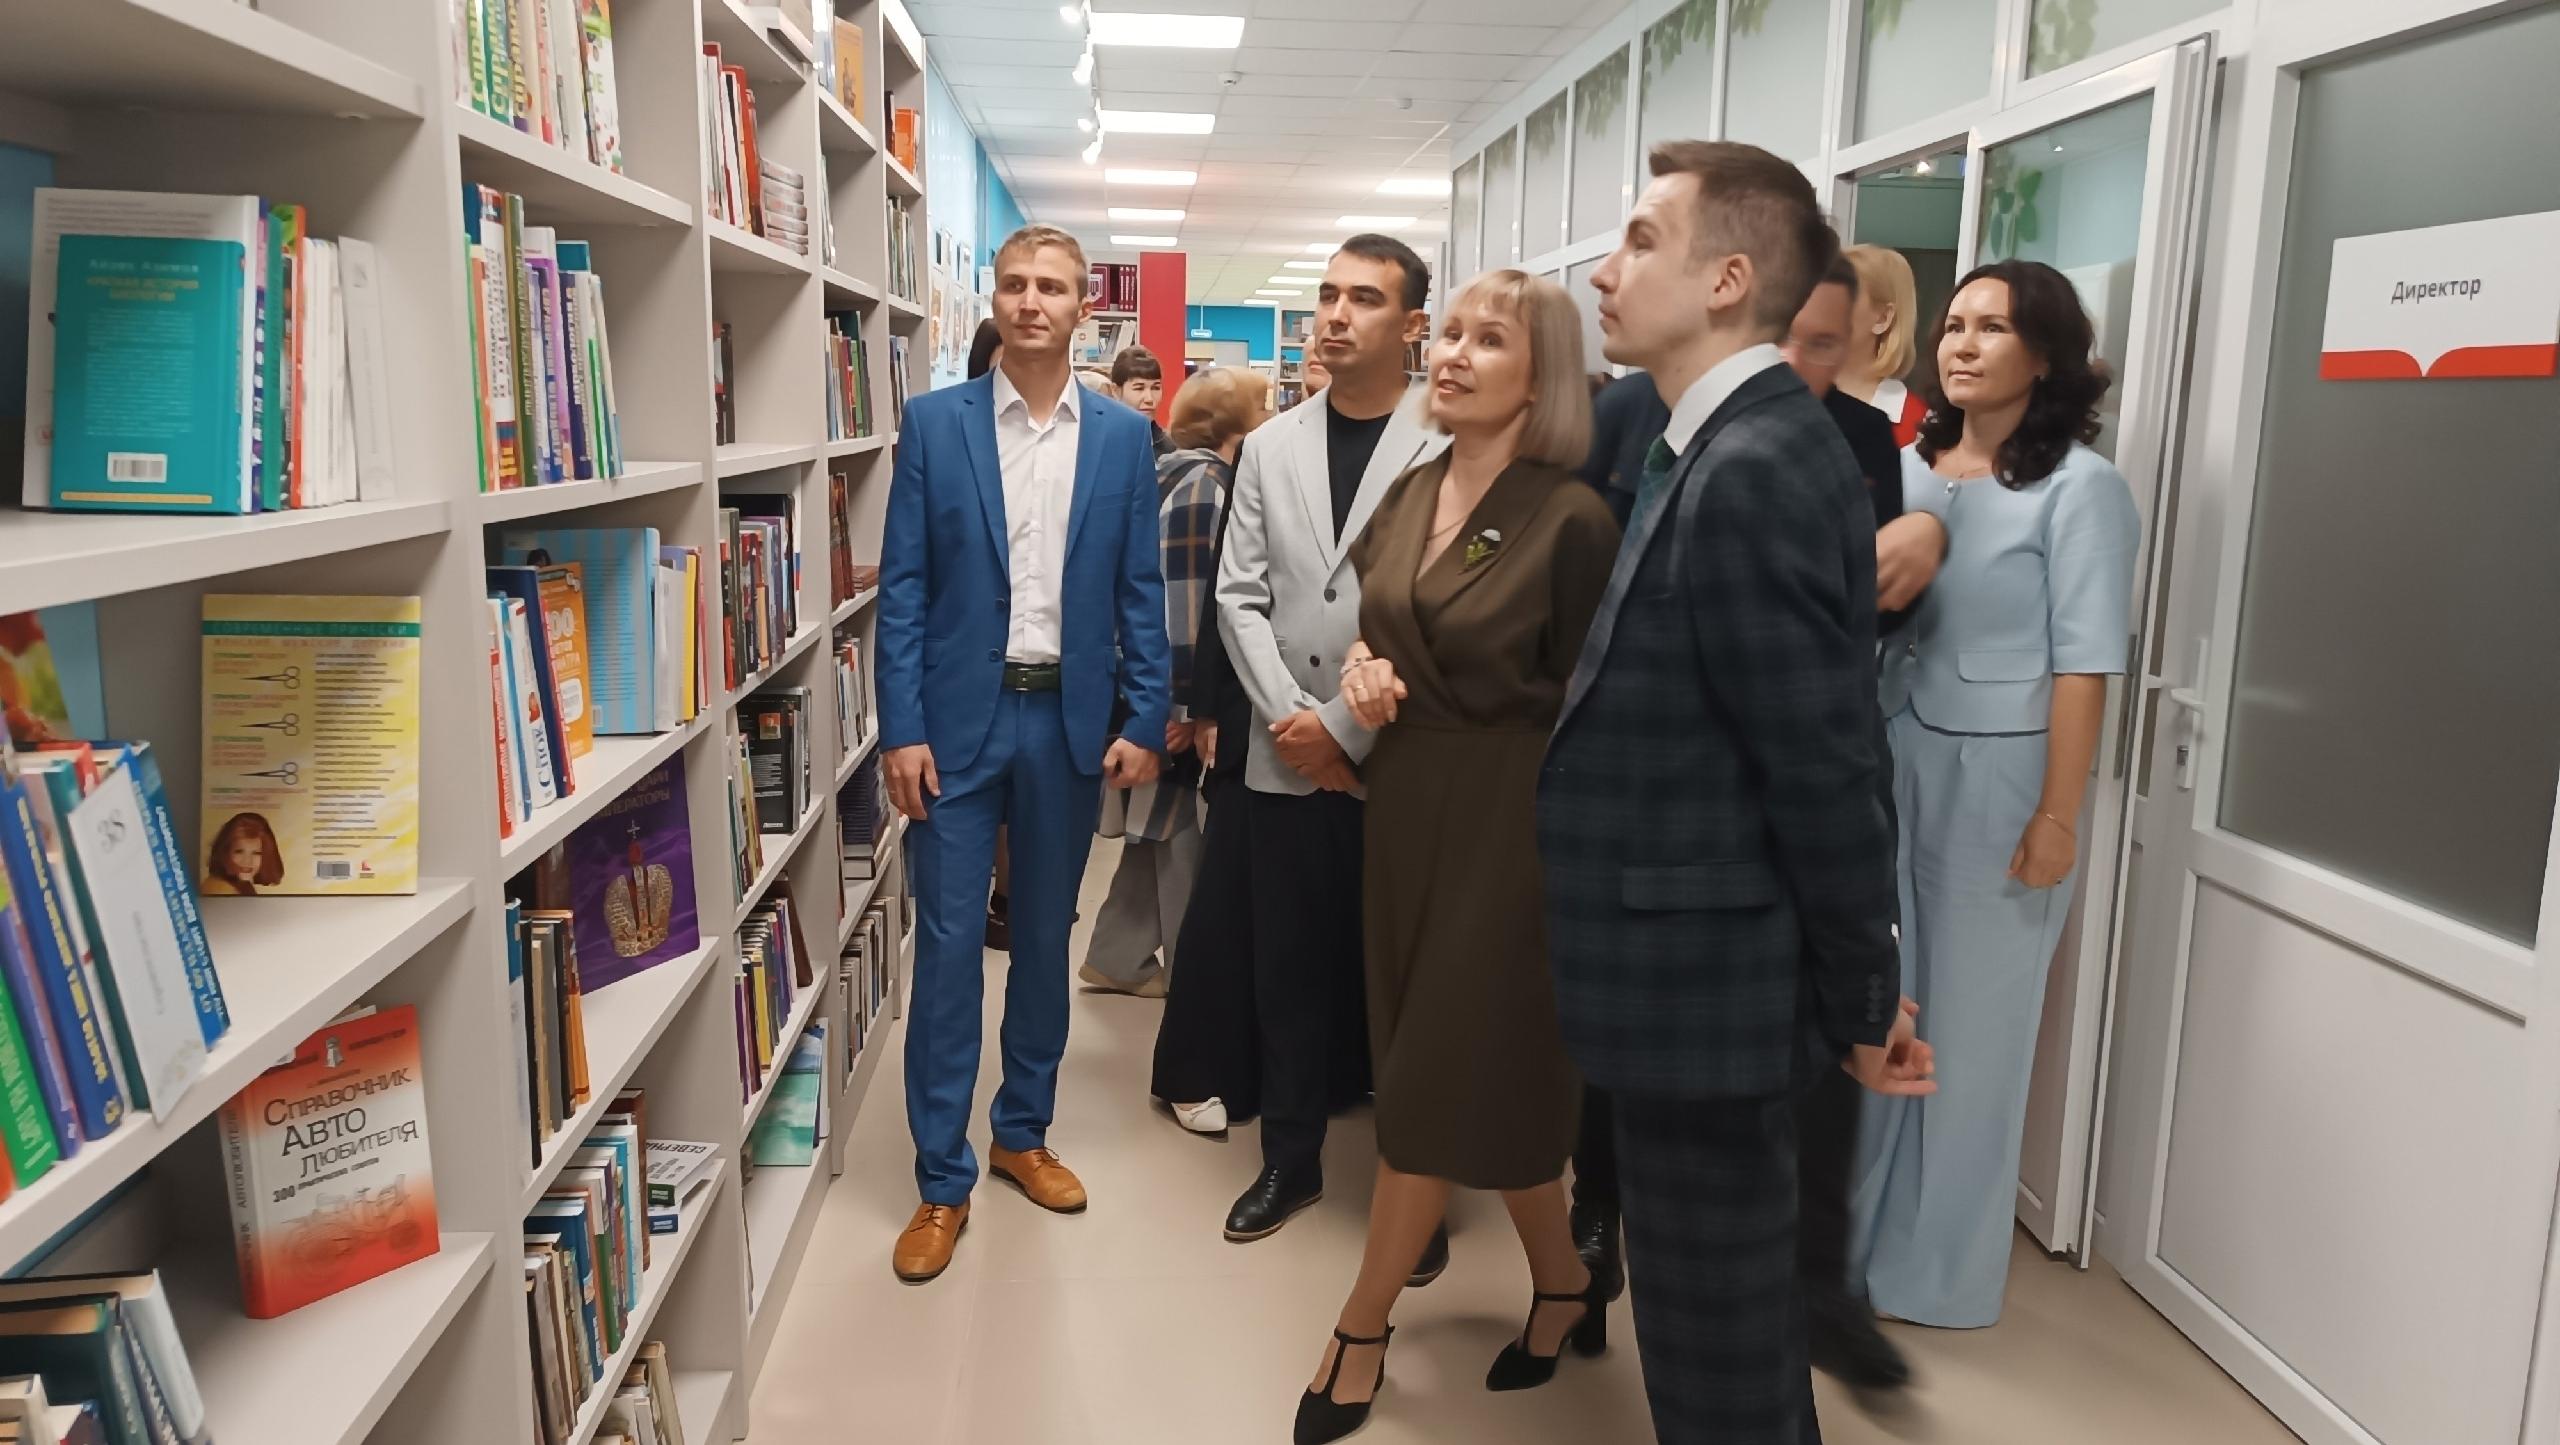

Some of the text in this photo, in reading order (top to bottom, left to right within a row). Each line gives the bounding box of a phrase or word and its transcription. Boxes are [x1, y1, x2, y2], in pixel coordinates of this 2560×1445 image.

[2391, 278, 2481, 304] Директор
[264, 1068, 412, 1127] СПРАВОЧНИК
[281, 1108, 366, 1156] АВТО
[300, 1120, 419, 1178] ЛЮБИТЕЛЯ
